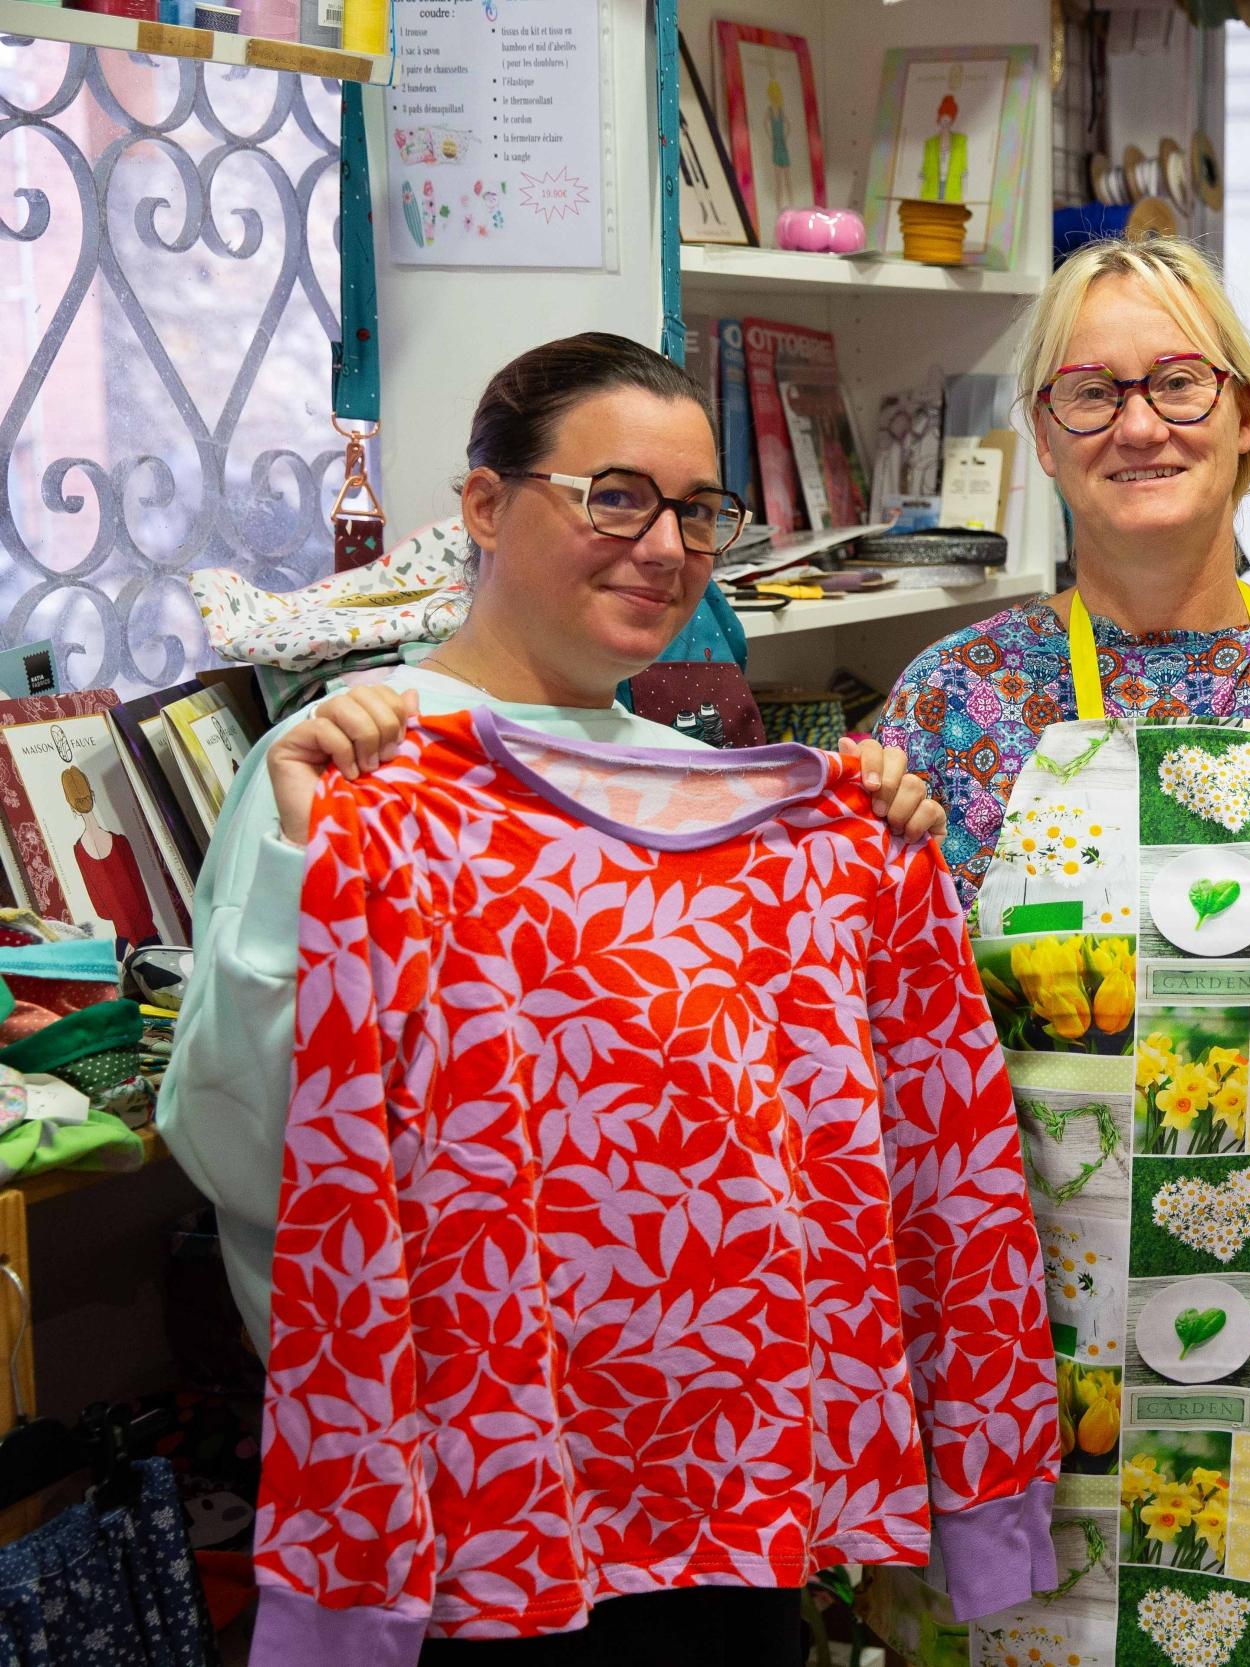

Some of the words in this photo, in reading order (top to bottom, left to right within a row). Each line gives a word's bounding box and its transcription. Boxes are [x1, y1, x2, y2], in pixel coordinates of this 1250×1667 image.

[420, 8, 450, 18] coudre
[405, 27, 428, 37] trousse
[520, 26, 529, 36] du
[531, 26, 540, 36] kit
[541, 26, 548, 36] et
[406, 48, 416, 56] sac
[423, 48, 440, 56] savon
[528, 43, 535, 52] et
[507, 60, 521, 70] pour
[523, 58, 532, 68] les
[533, 57, 564, 68] doublures
[407, 64, 422, 76] paire
[424, 64, 432, 74] de
[433, 63, 468, 74] chaussettes
[408, 82, 437, 93] bandeaux
[510, 96, 553, 105] thermocollant
[409, 103, 422, 115] pads
[510, 114, 532, 124] cordon
[511, 151, 531, 164] sangle
[21, 743, 55, 756] MAISON
[70, 736, 96, 749] FAUVE
[1146, 1402, 1234, 1416] GARDEN
